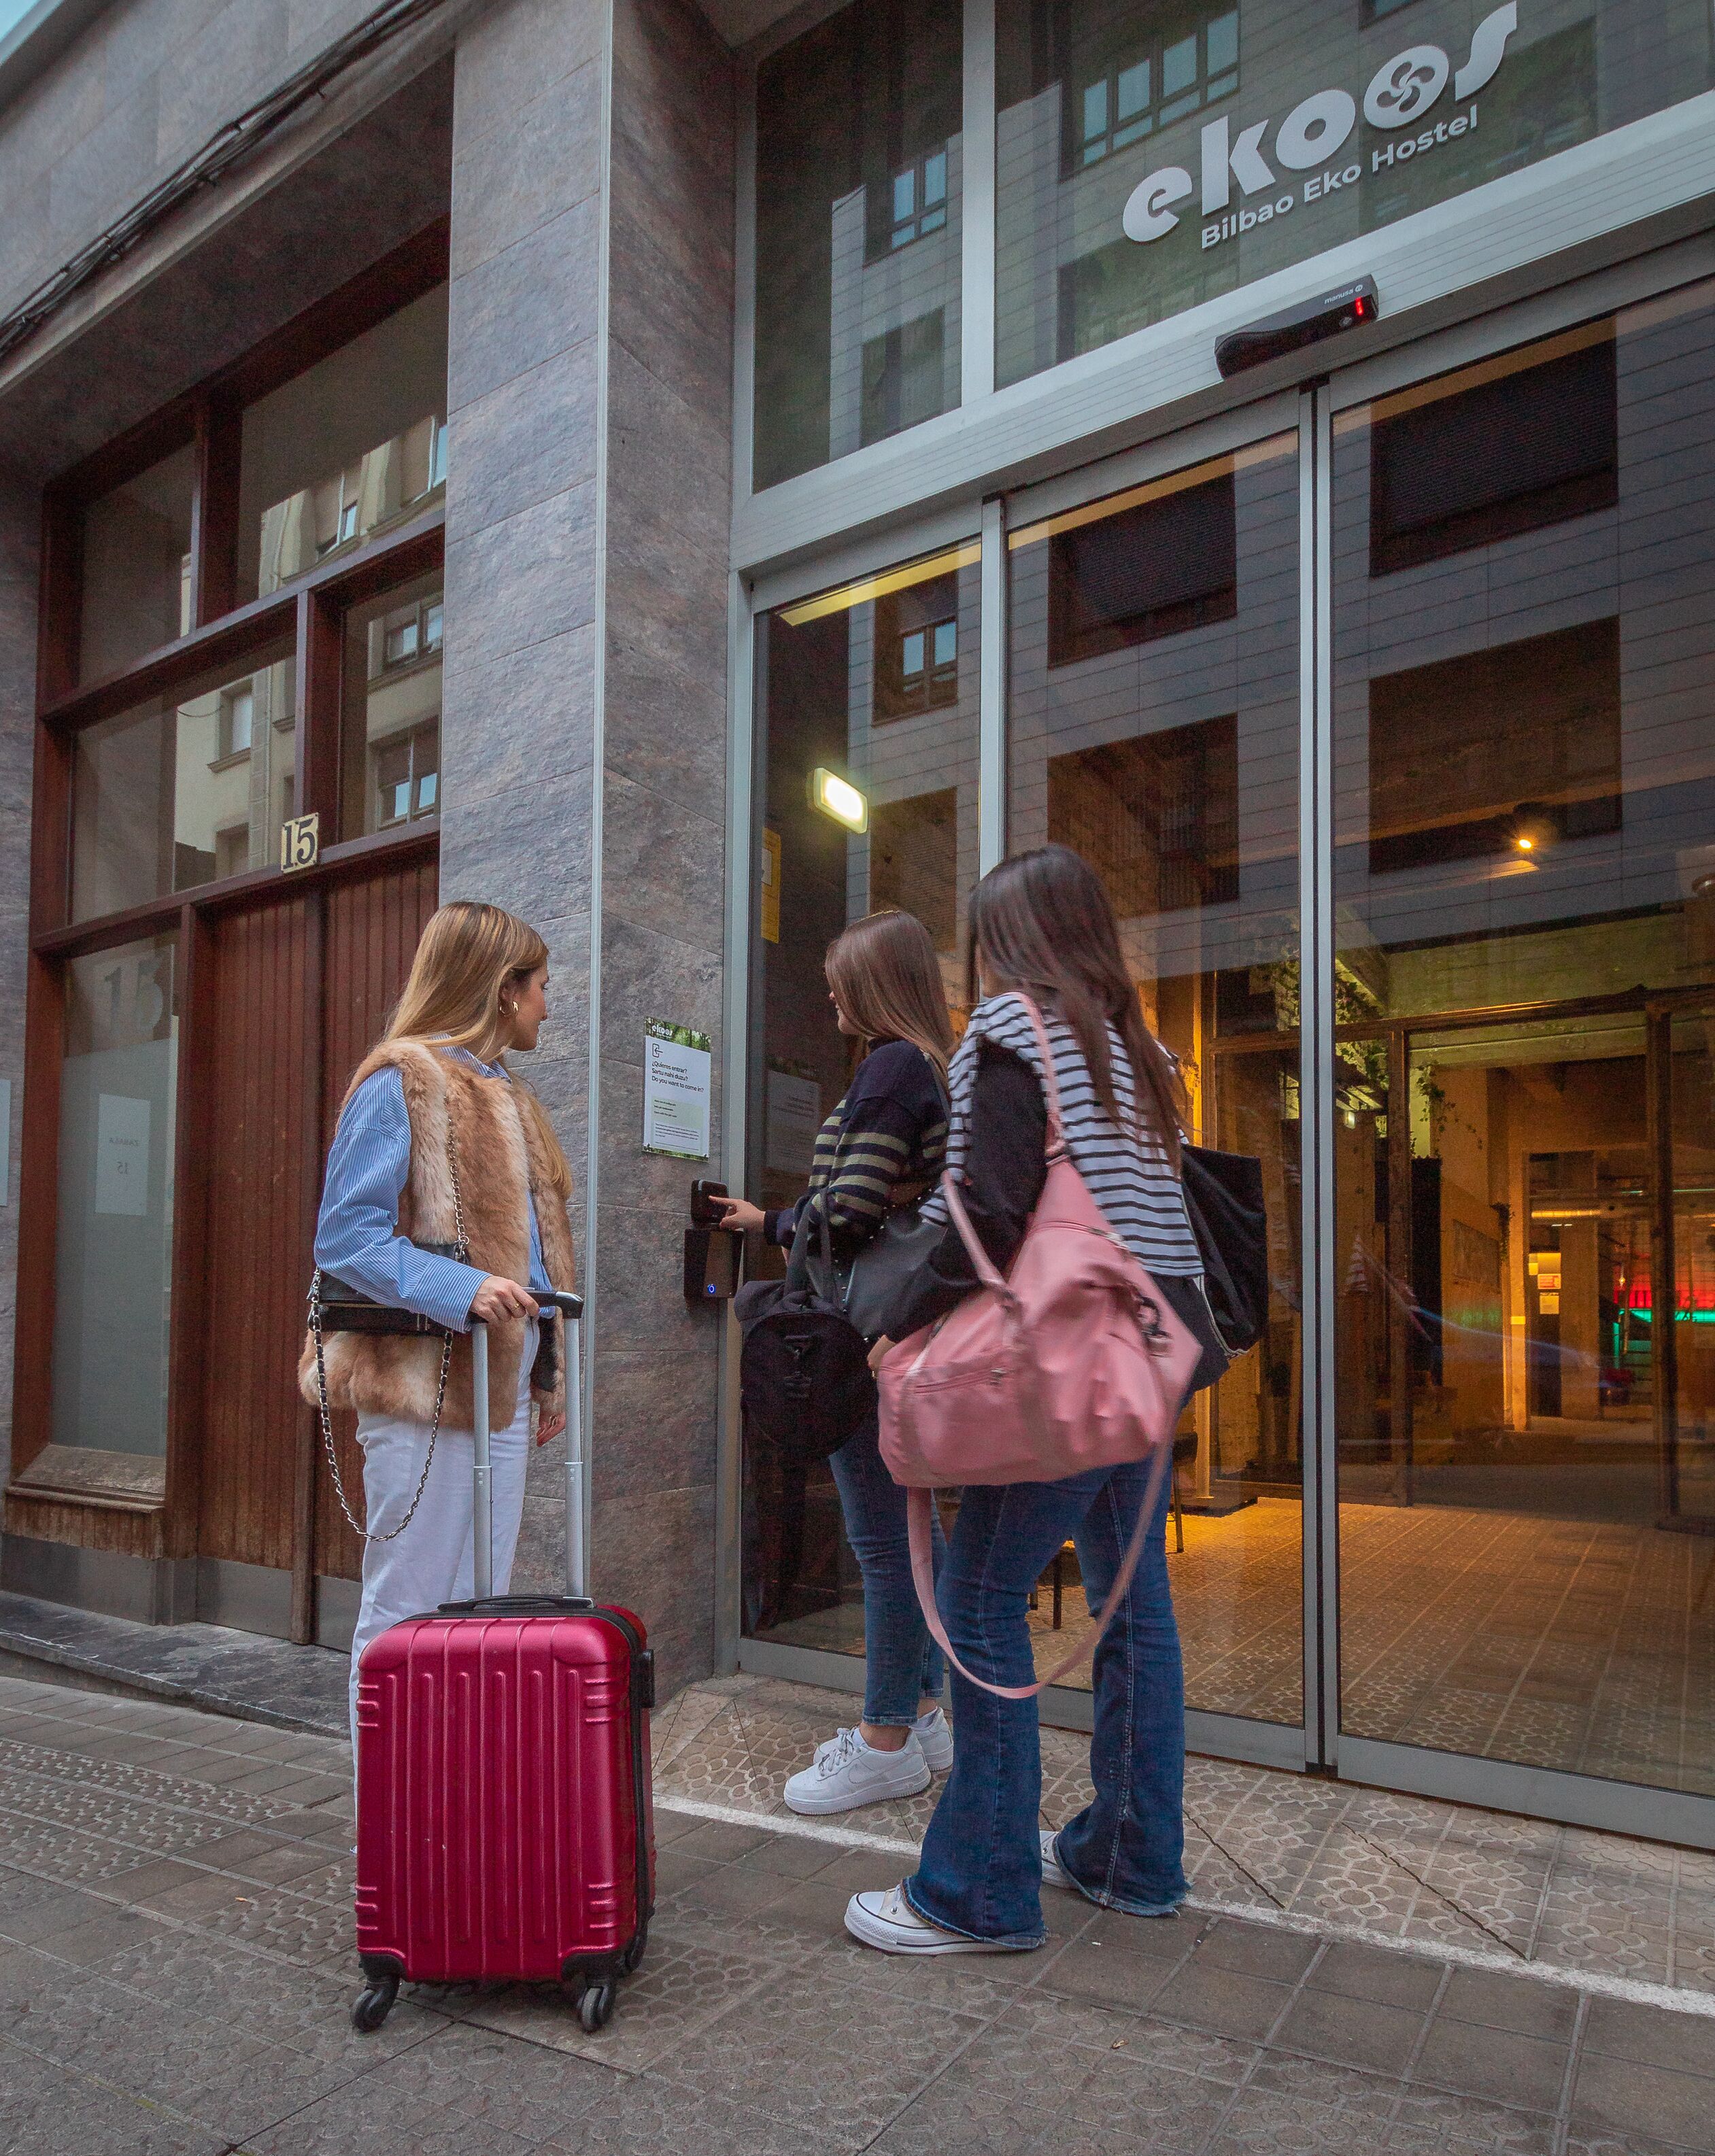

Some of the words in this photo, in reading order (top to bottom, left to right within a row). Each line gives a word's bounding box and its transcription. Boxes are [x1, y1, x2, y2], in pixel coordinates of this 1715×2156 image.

[1123, 1, 1517, 242] ekoos
[1201, 194, 1294, 249] Bilbao
[1304, 165, 1361, 203] Eko
[1372, 105, 1478, 173] Hostel
[1324, 288, 1354, 305] manusa
[283, 818, 316, 870] 15
[105, 956, 163, 1036] 15
[651, 1061, 671, 1070] ¿Quieres
[671, 1065, 687, 1074] entrar?
[674, 1074, 688, 1082] duzu?
